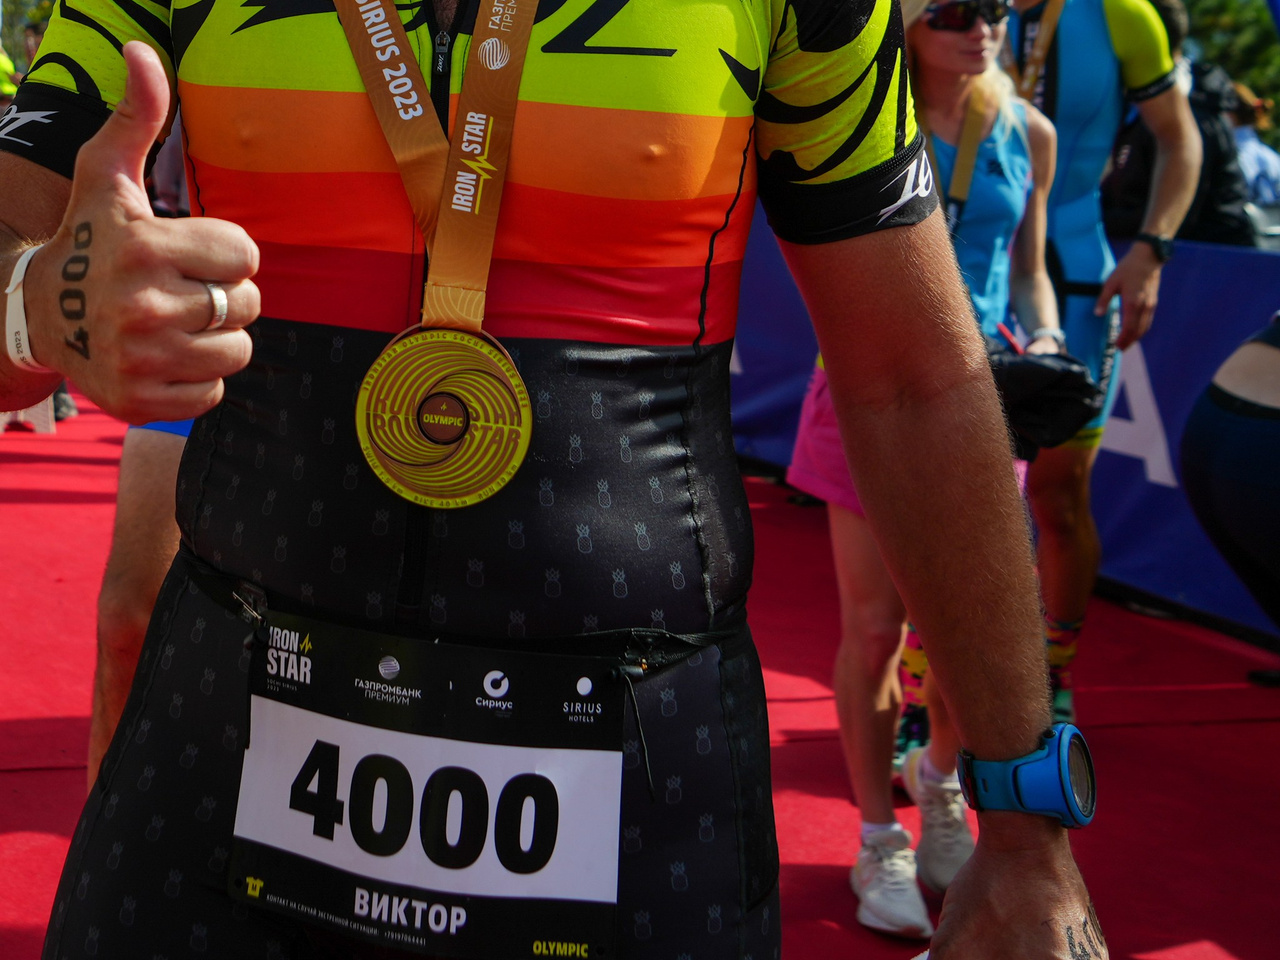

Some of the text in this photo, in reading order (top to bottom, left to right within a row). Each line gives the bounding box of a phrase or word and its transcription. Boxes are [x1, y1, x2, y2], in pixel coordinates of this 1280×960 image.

[382, 61, 424, 122] 2023
[450, 110, 488, 213] IRON STAR
[59, 221, 93, 360] 4000
[423, 414, 464, 427] OLYMPIC
[269, 625, 300, 653] IRON
[266, 647, 312, 685] STAR
[354, 678, 423, 699] ГАЗПРОМБАНК
[364, 689, 411, 706] ПРЕМИУМ
[475, 696, 513, 710] Сириус
[562, 701, 602, 714] SIRIUS
[568, 715, 595, 723] HOTELS
[288, 739, 559, 875] 4000
[354, 886, 467, 935] ВИКТОР
[532, 940, 589, 958] OLYMPIC
